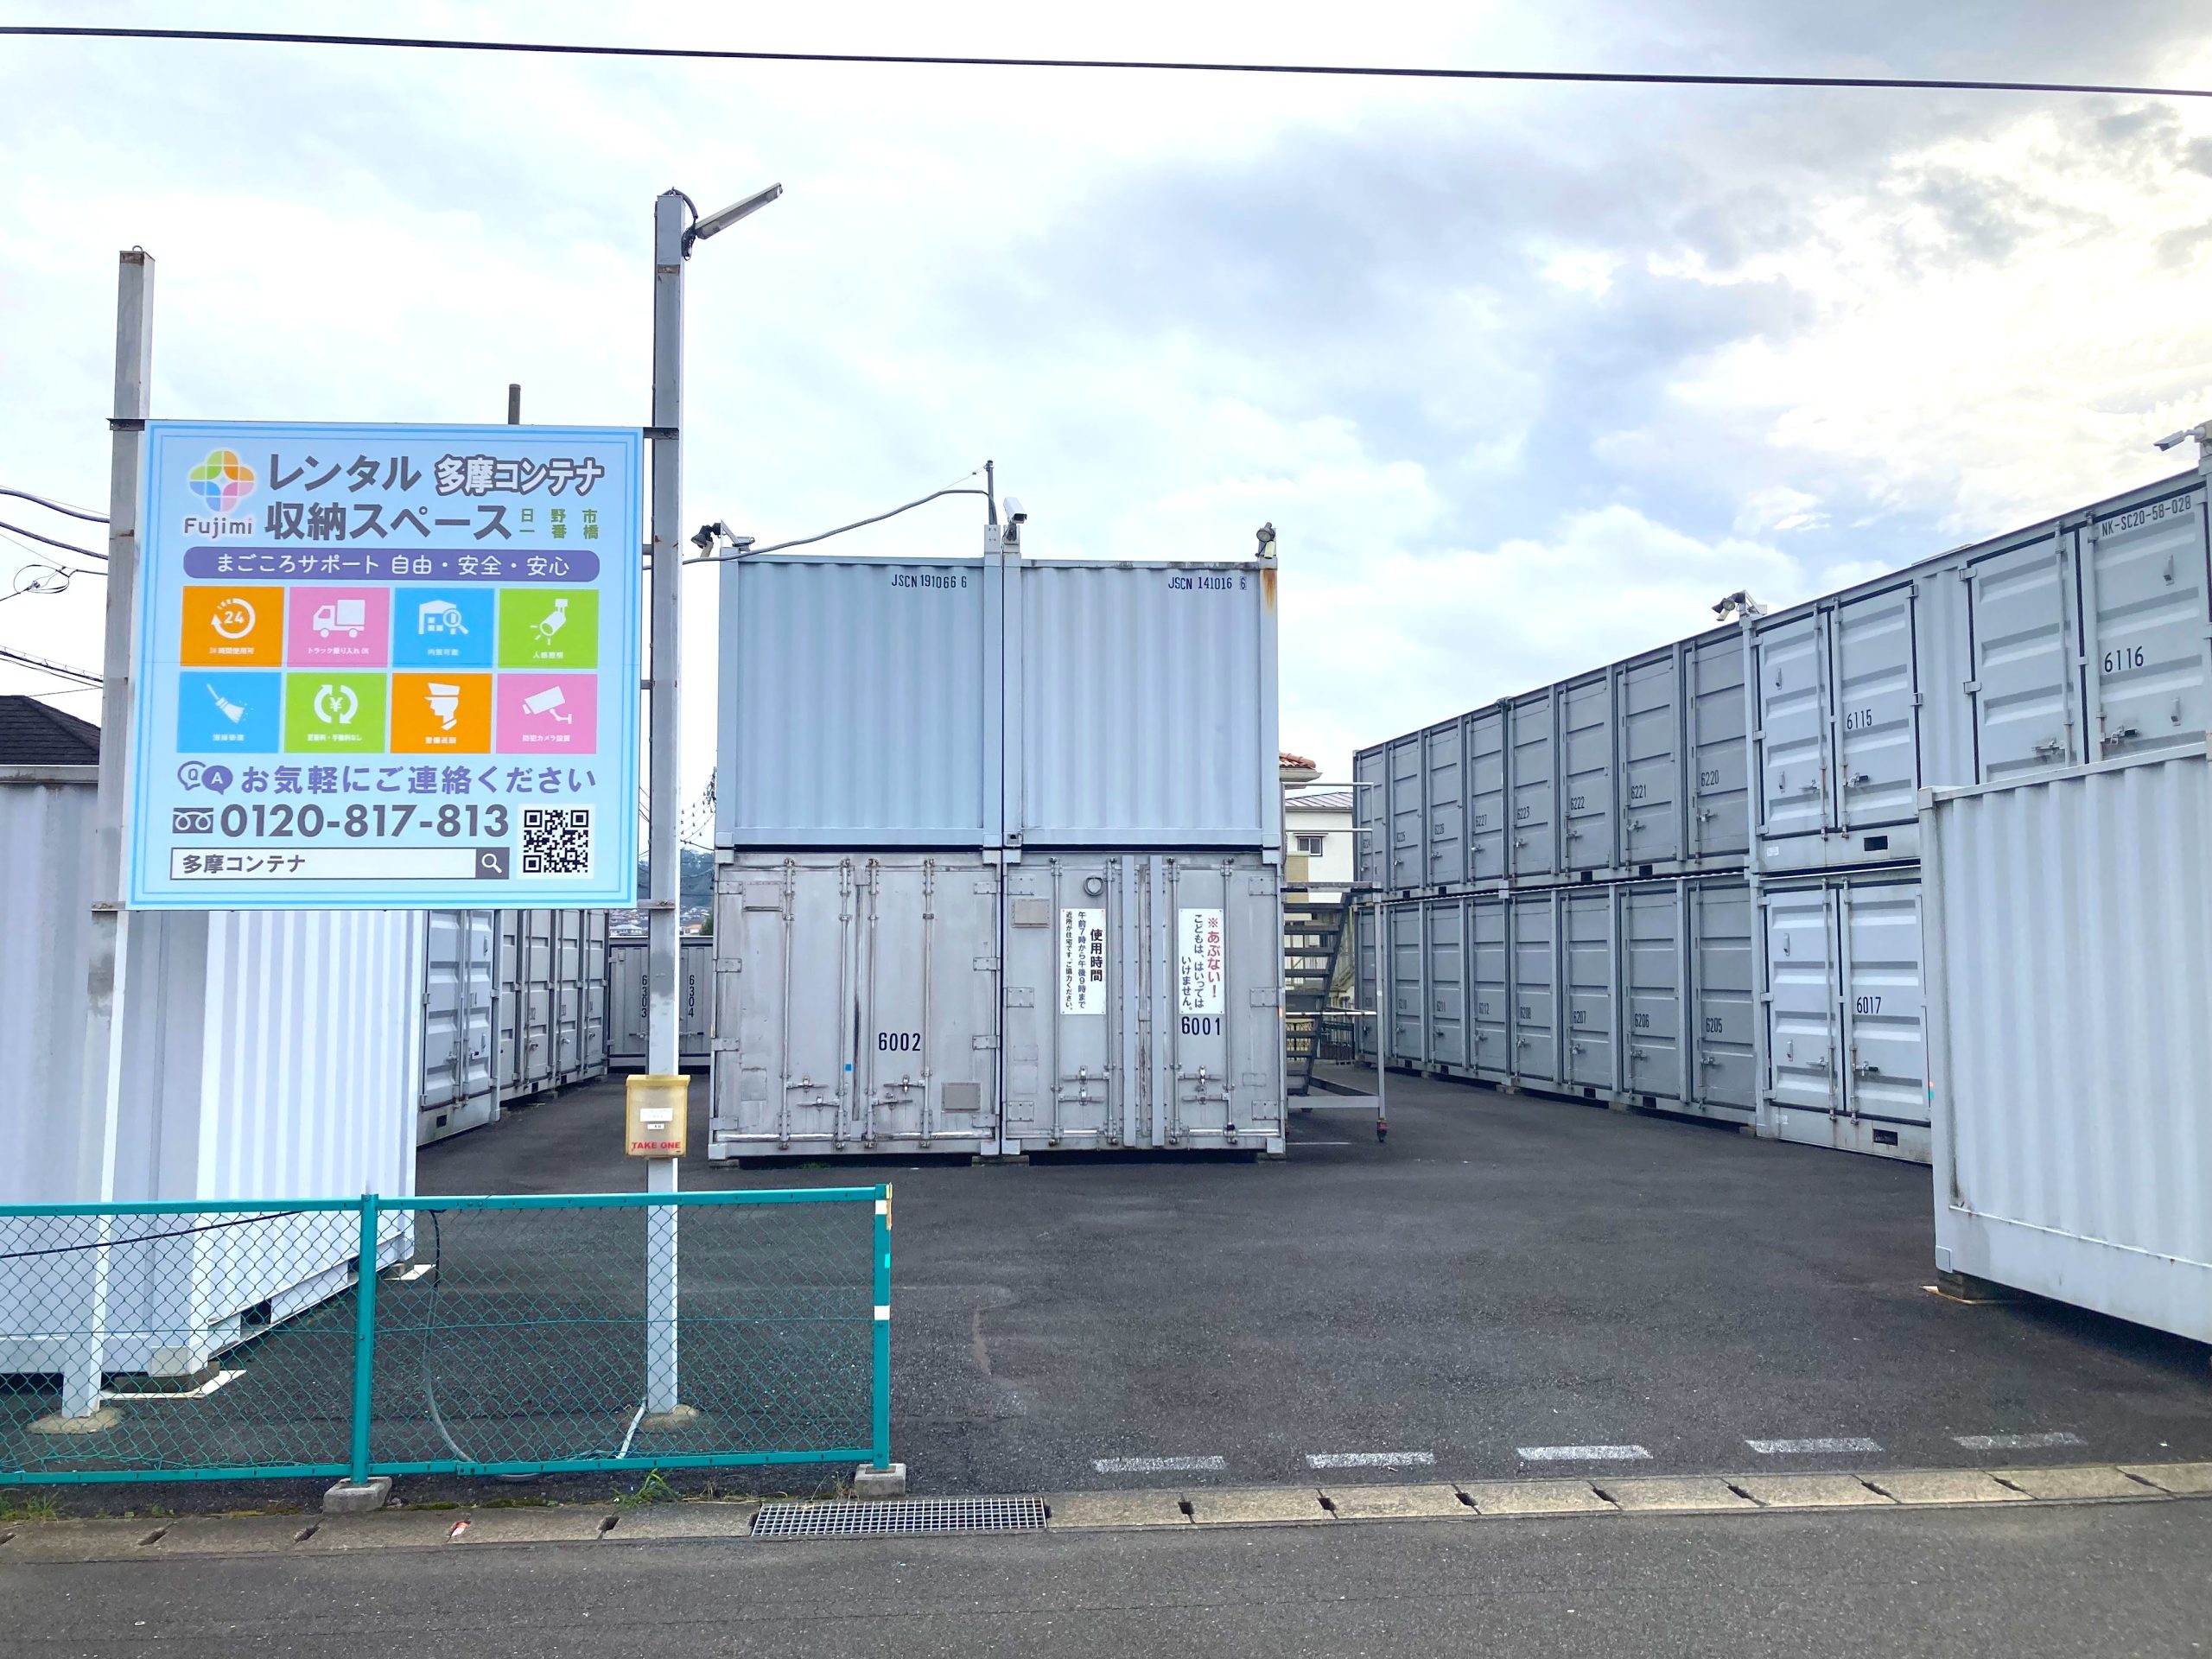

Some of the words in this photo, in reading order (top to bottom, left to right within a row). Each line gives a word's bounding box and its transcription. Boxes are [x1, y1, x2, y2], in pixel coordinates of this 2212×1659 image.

[270, 454, 422, 493] レンタル
[434, 454, 605, 496] 多摩コンテナ
[184, 517, 253, 539] Fujimi
[264, 501, 512, 541] 収納スペース
[217, 553, 379, 575] まごころサポート
[391, 554, 570, 577] 自由・安全・安心
[891, 574, 918, 588] JSCN
[920, 574, 957, 588] 191066
[961, 575, 967, 588] 6
[1168, 576, 1192, 590] JSCN
[1198, 577, 1232, 590] 141016
[1240, 576, 1247, 591] 6
[223, 610, 245, 625] 24
[2104, 645, 2145, 672] 6116
[1846, 709, 1873, 730] 6115
[188, 768, 199, 781] Q
[211, 772, 223, 785] A
[241, 765, 596, 795] お気軽にご連絡ください
[1700, 769, 1719, 787] 6220
[1630, 785, 1648, 800] 6221
[1570, 795, 1586, 810] 6222
[220, 804, 509, 837] 0120-817-813
[182, 854, 306, 874] 多摩コンテナ
[1090, 928, 1103, 982] 使用時間
[1856, 996, 1882, 1014] 6017
[1181, 1016, 1221, 1036] 6001
[1573, 1010, 1586, 1024] 6207
[1634, 1014, 1649, 1028] 6206
[1706, 1017, 1723, 1033] 6205
[878, 1032, 921, 1052] 6002
[660, 1141, 681, 1149] ONE
